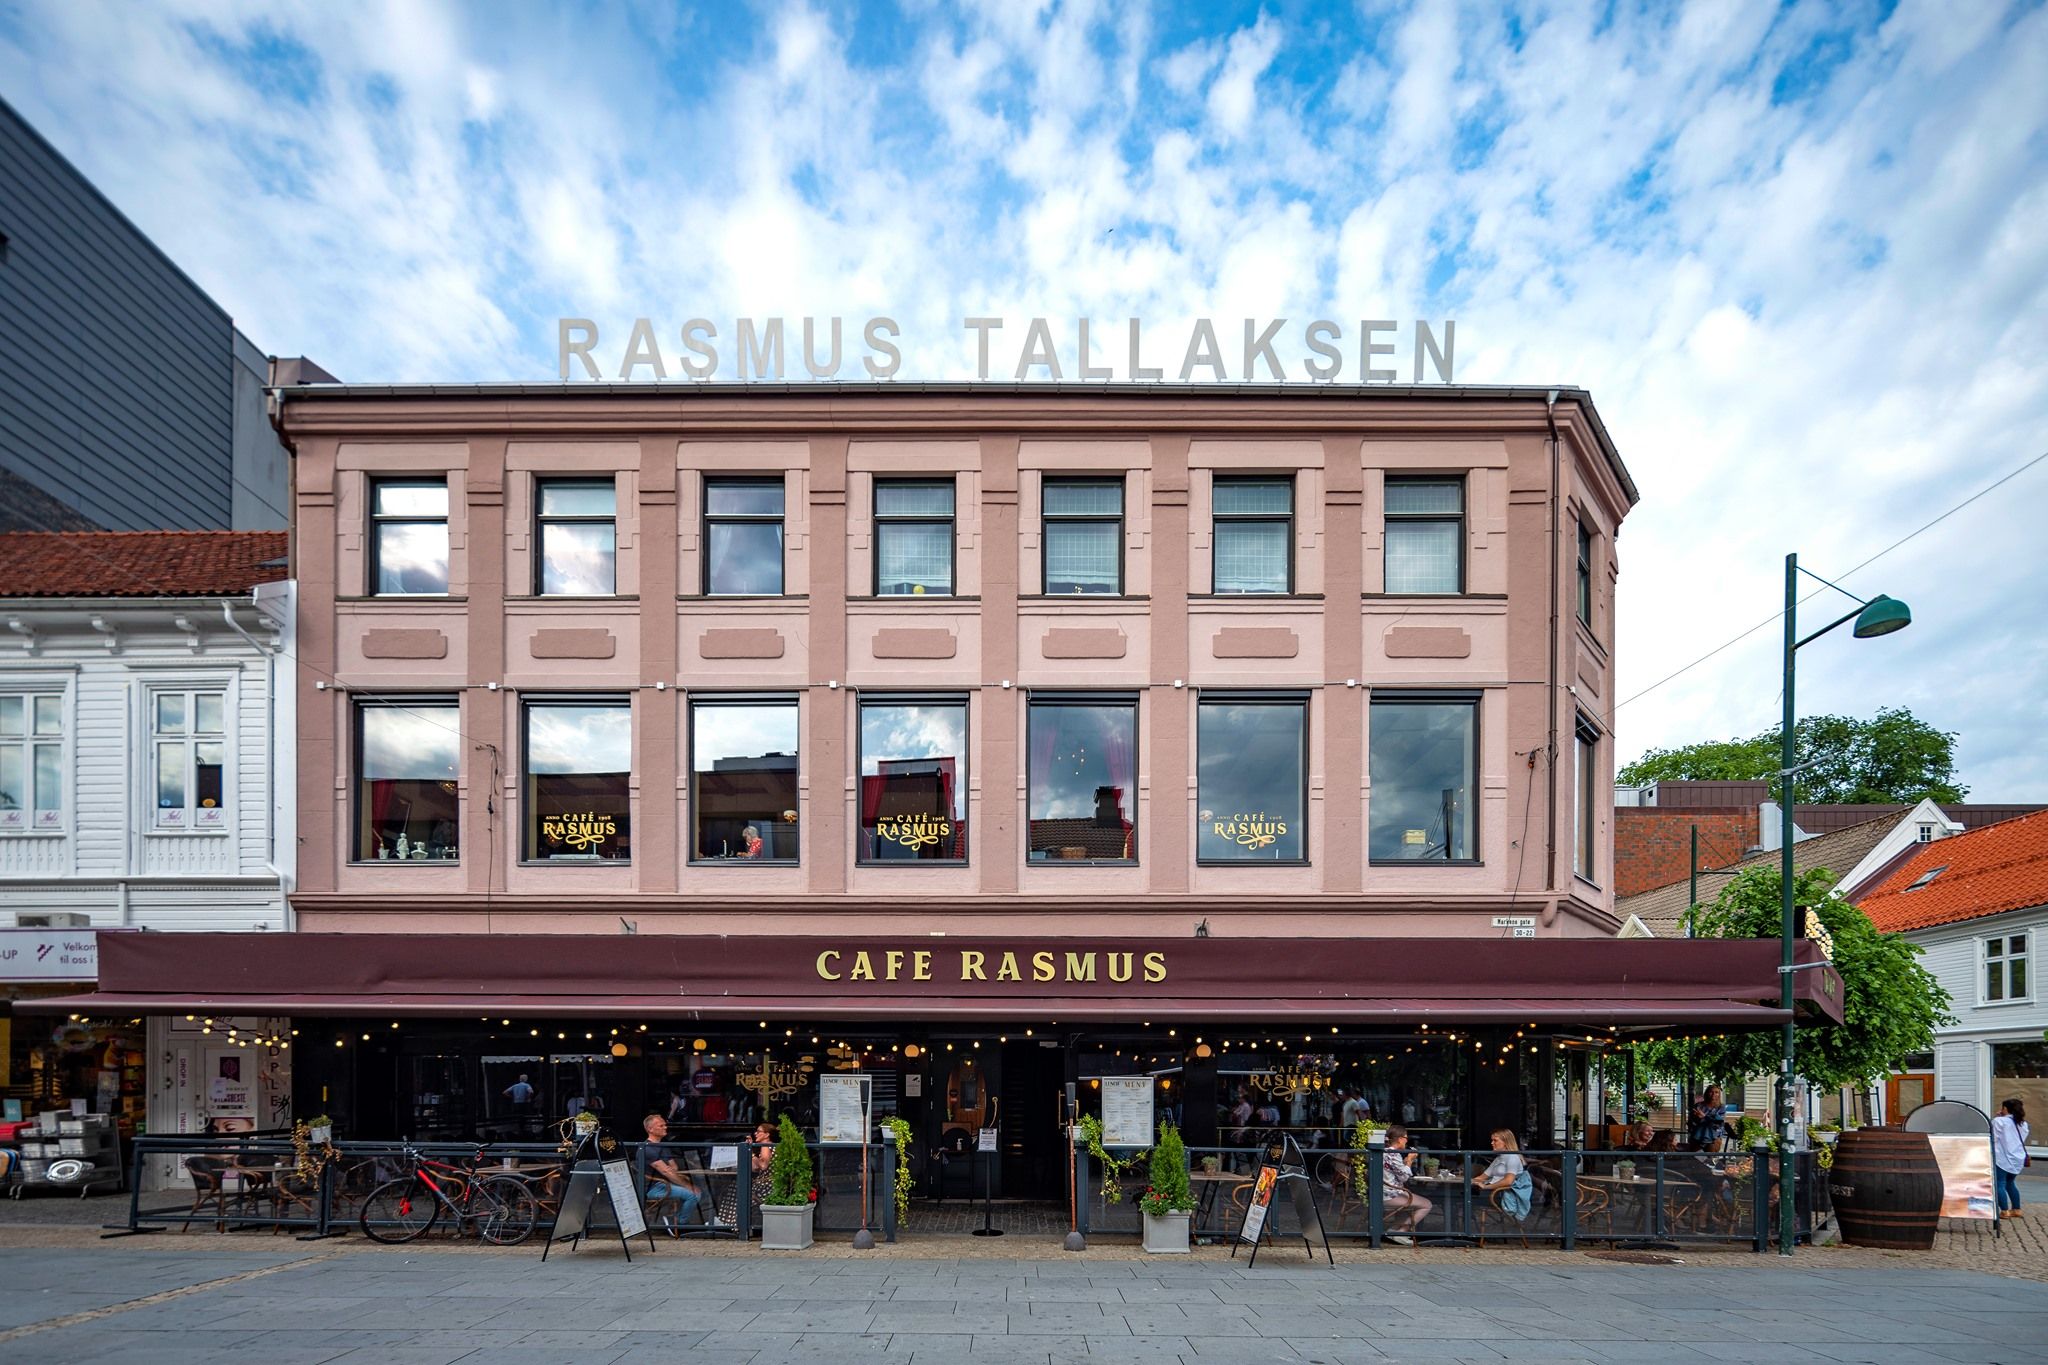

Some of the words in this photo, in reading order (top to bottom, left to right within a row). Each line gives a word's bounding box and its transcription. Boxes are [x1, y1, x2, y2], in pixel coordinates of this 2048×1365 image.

[559, 318, 900, 378] RASMUS
[964, 317, 1456, 381] TALLAKSEN
[563, 811, 594, 822] CAFÉ
[897, 812, 928, 823] CAFÉ
[1234, 811, 1265, 822] CAFÉ
[543, 822, 616, 840] RASMUS
[877, 823, 950, 841] RASMUS
[1214, 822, 1287, 840] RASMUS
[60, 955, 70, 964] til
[72, 956, 88, 964] oss
[816, 950, 933, 981] CAFE
[960, 951, 1168, 982] RASMUS
[1250, 1074, 1322, 1091] RASMUS
